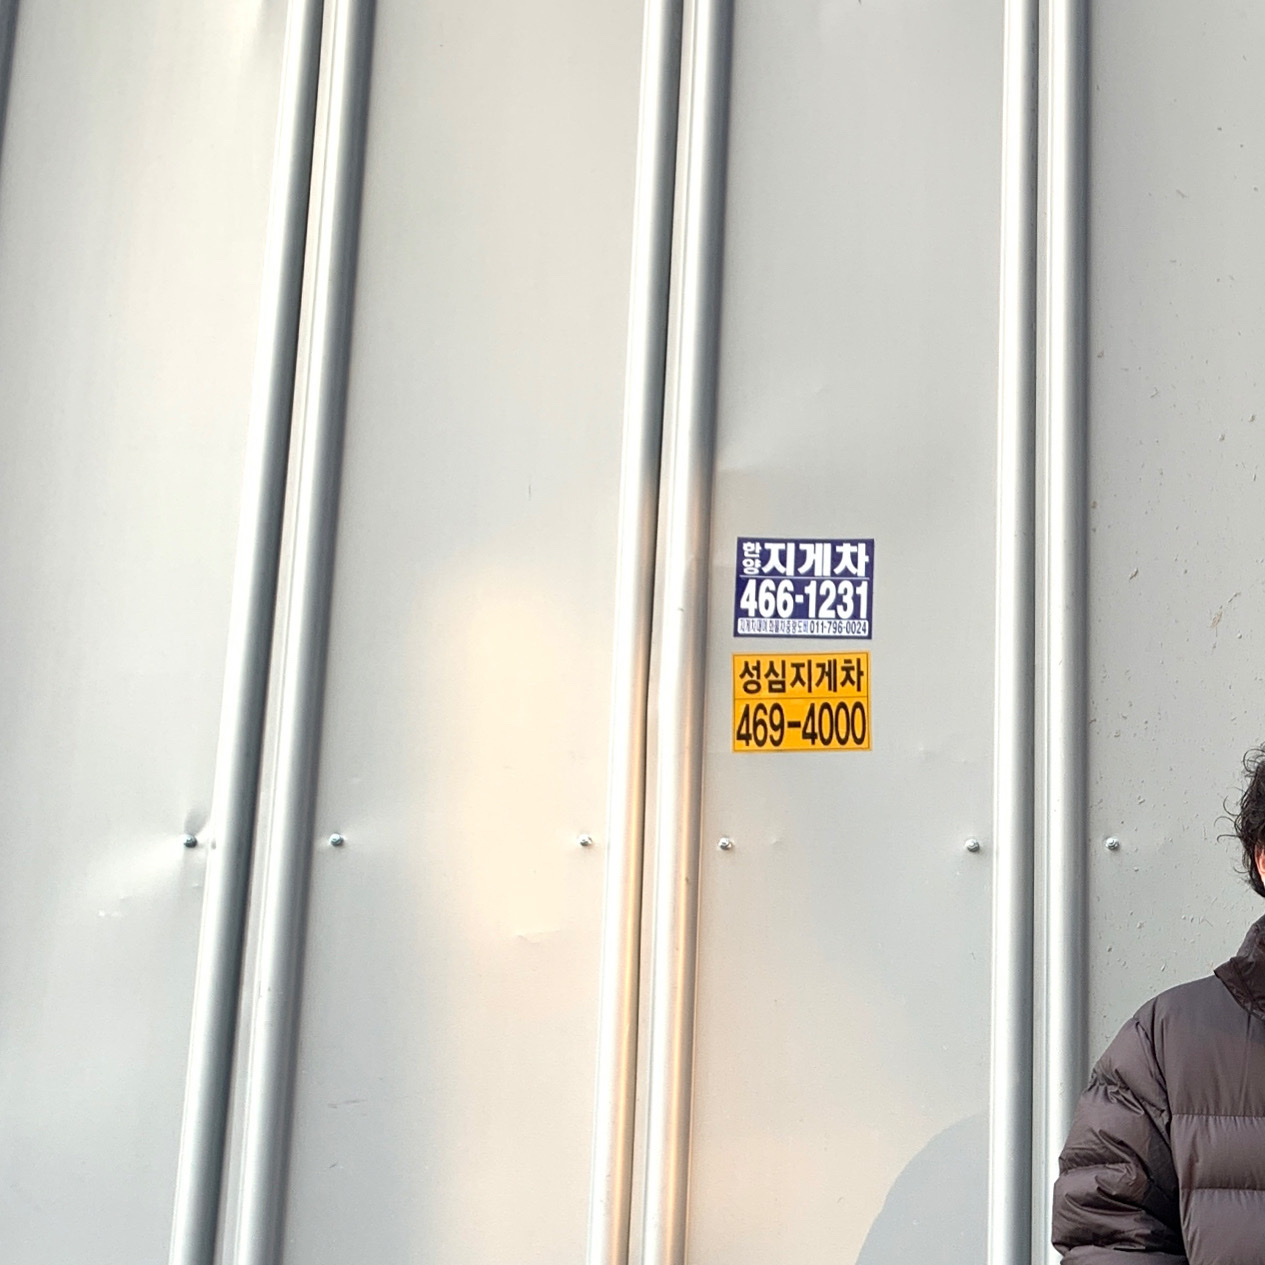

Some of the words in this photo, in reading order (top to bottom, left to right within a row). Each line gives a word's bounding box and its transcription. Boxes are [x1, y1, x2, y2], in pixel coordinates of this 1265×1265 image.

[762, 542, 870, 577] 지게차
[740, 578, 868, 619] 466-1231
[809, 621, 867, 635] 011-796-0024
[739, 657, 864, 694] 성심지게차
[736, 701, 867, 747] 469-4000
